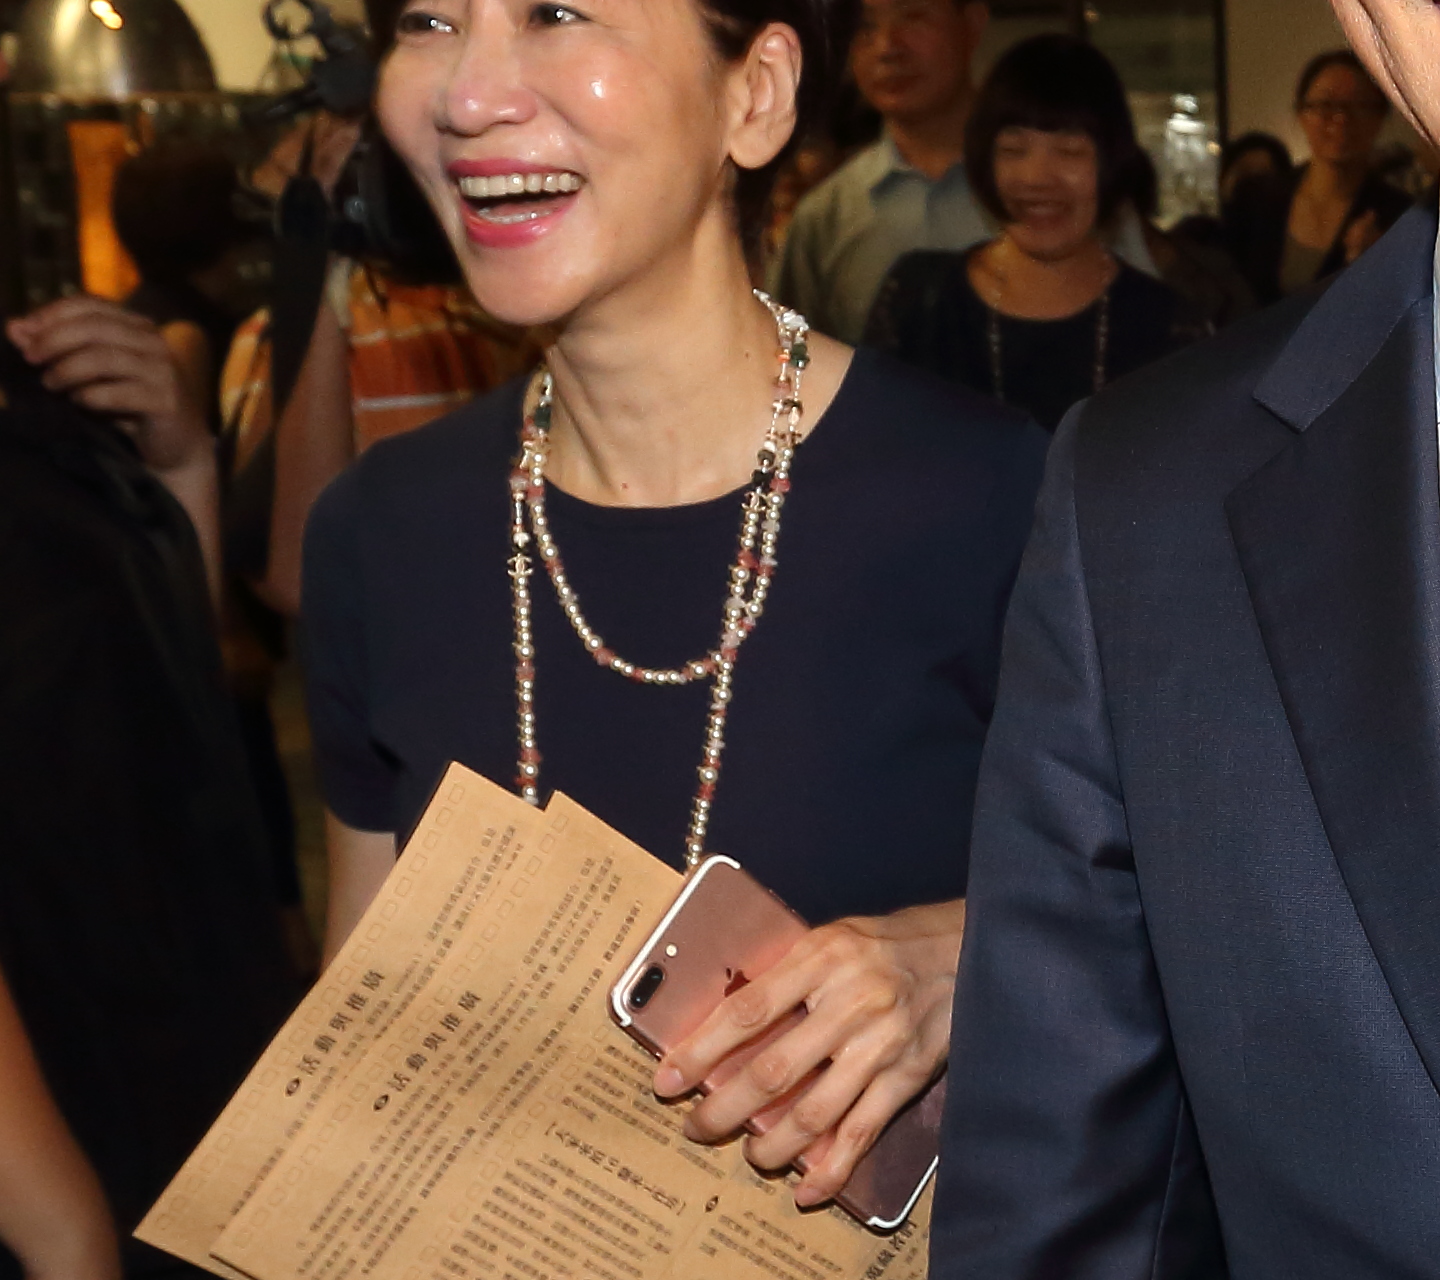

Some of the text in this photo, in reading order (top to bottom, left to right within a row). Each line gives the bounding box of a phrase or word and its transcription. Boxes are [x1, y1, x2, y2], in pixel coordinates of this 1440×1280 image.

[300, 968, 383, 1077] 活動與推廣
[392, 989, 480, 1093] 活動與推廣
